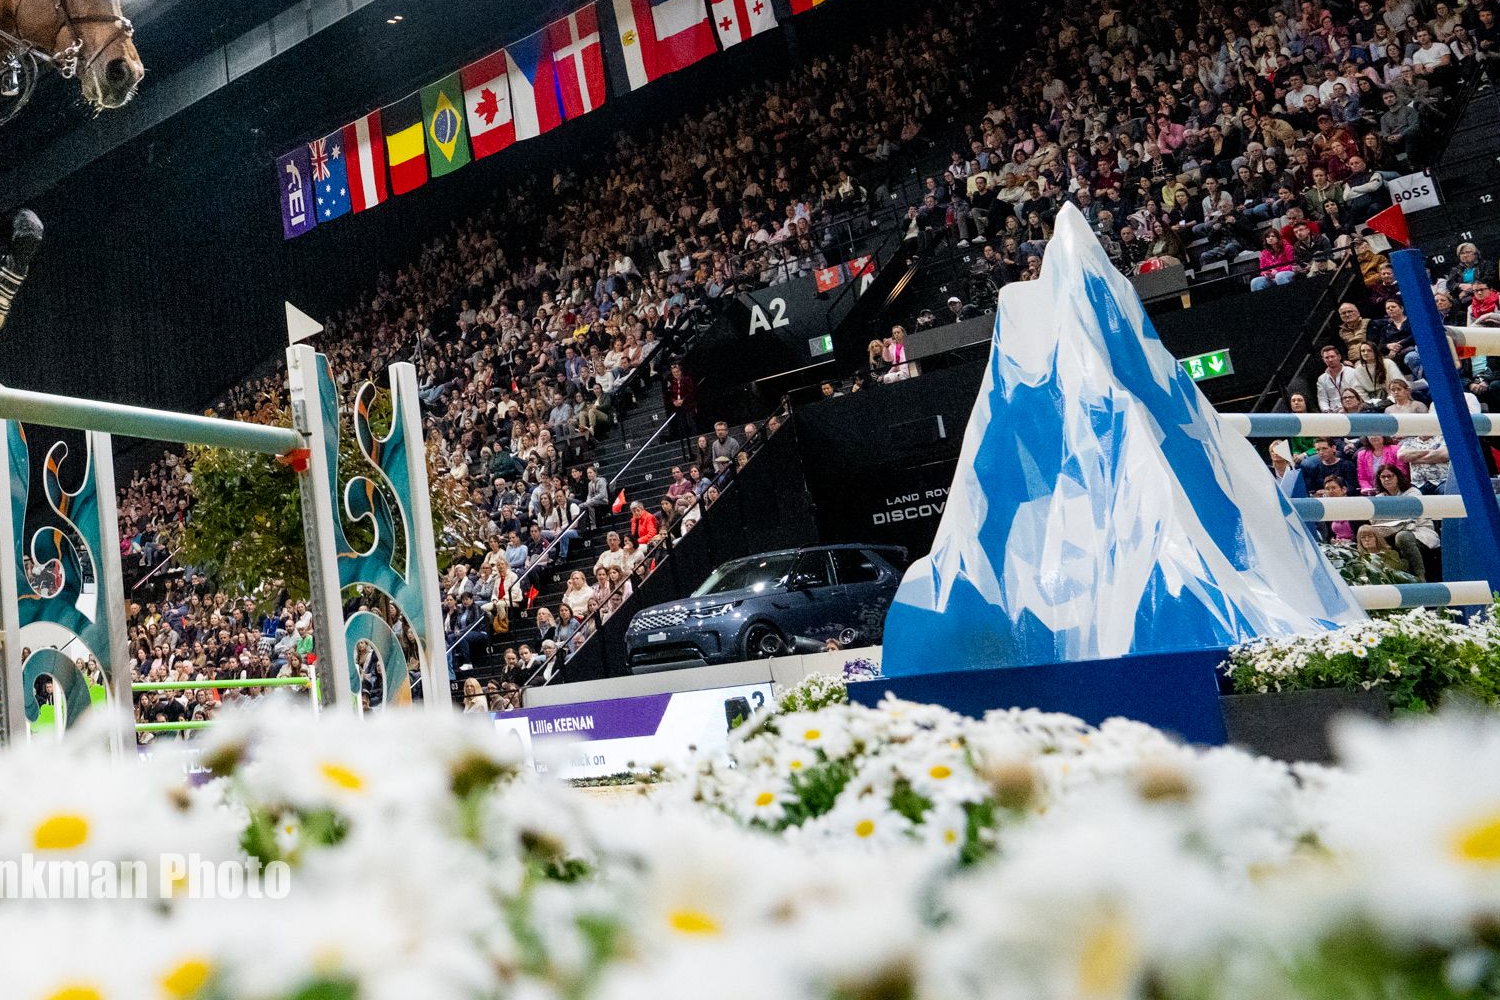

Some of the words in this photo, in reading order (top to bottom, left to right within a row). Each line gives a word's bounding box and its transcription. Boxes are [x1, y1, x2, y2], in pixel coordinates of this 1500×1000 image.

[1394, 185, 1430, 203] BOSS
[1480, 195, 1493, 203] 12
[1461, 231, 1472, 240] 11
[1432, 255, 1445, 264] 10
[748, 297, 790, 336] A2
[886, 493, 920, 506] LAND
[872, 501, 946, 525] DISCOV
[531, 717, 553, 735] Lillie
[555, 715, 594, 733] KEENAN
[593, 754, 606, 766] on
